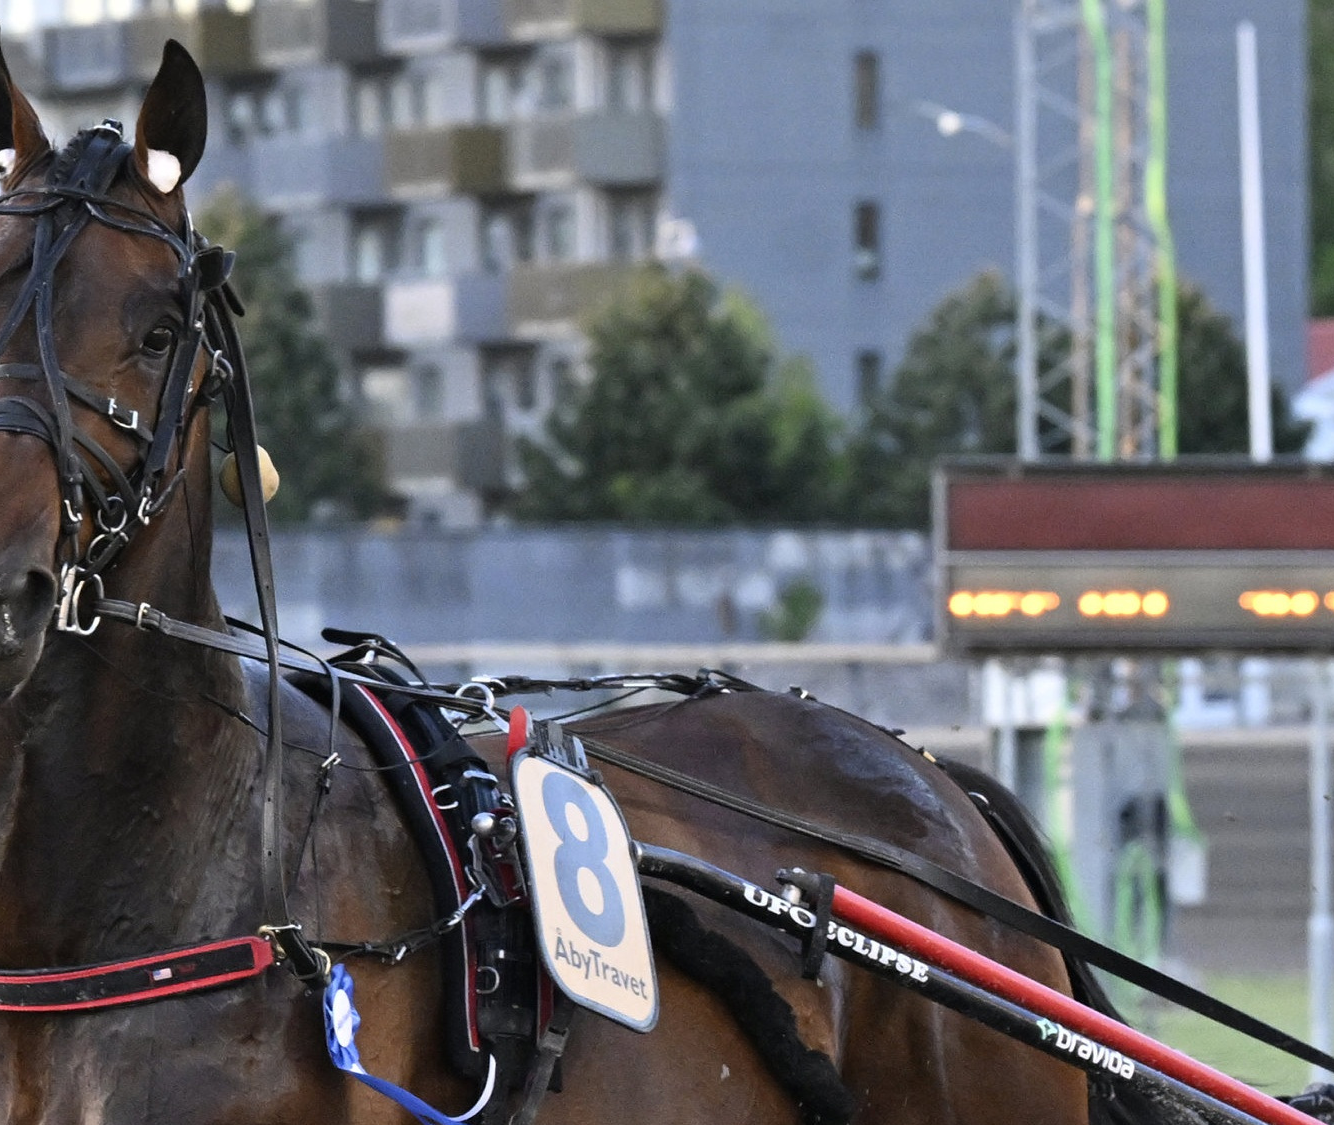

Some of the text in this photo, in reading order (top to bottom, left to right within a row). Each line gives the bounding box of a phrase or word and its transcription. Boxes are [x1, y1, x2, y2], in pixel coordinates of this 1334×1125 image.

[542, 772, 625, 947] 8
[743, 882, 817, 928] UFO
[555, 927, 648, 1000] ÅbyTravet
